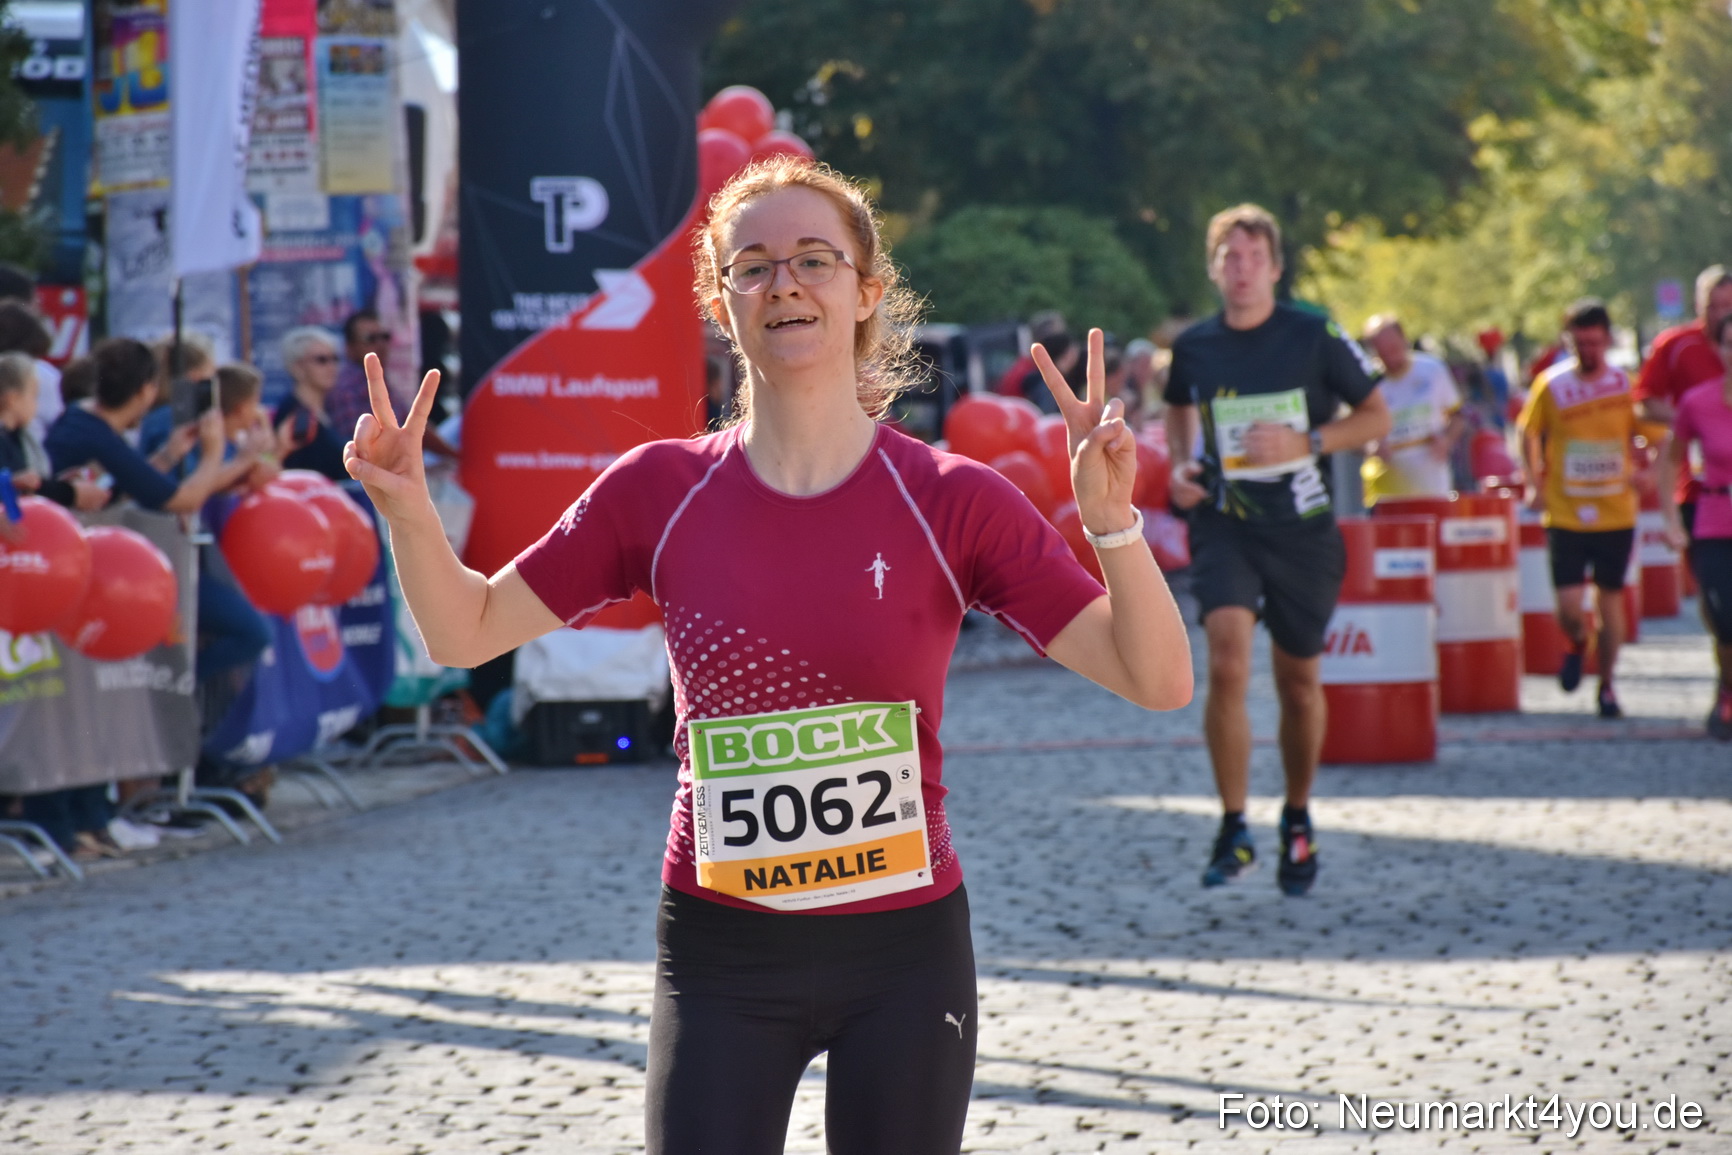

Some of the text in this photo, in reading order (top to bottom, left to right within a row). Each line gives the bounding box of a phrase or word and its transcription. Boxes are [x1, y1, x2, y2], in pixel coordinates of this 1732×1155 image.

[706, 708, 898, 771] BOCK
[722, 770, 896, 847] 5062
[743, 848, 887, 891] NATALIE
